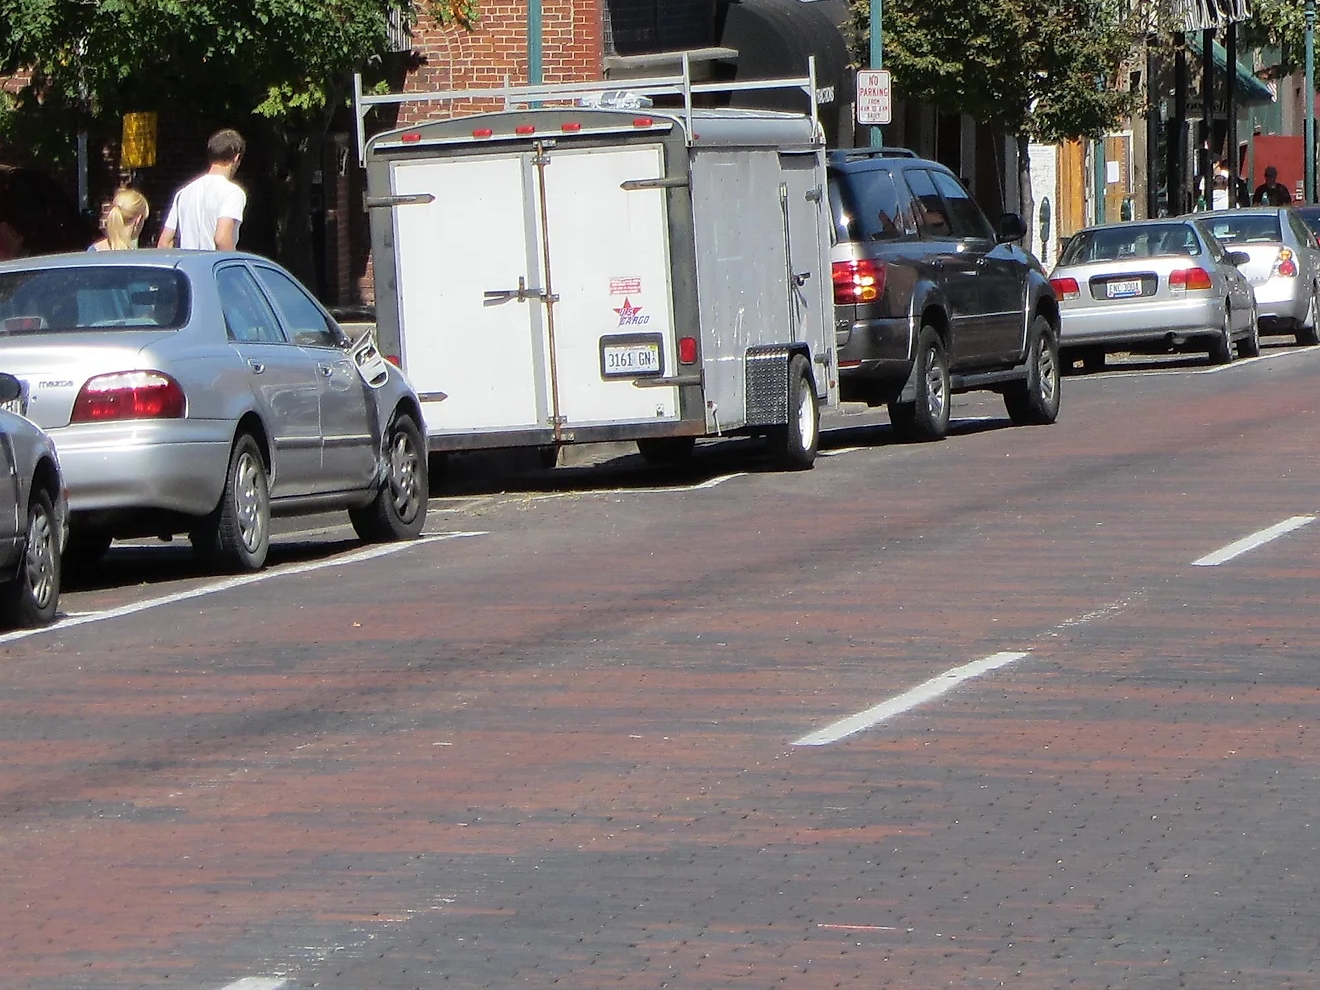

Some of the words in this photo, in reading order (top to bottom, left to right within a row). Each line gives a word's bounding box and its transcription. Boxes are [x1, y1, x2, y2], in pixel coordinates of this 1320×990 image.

[868, 75, 879, 86] NO
[860, 88, 888, 97] PARKING
[619, 315, 650, 325] CARGO
[609, 352, 633, 367] 3161
[638, 351, 651, 366] GN
